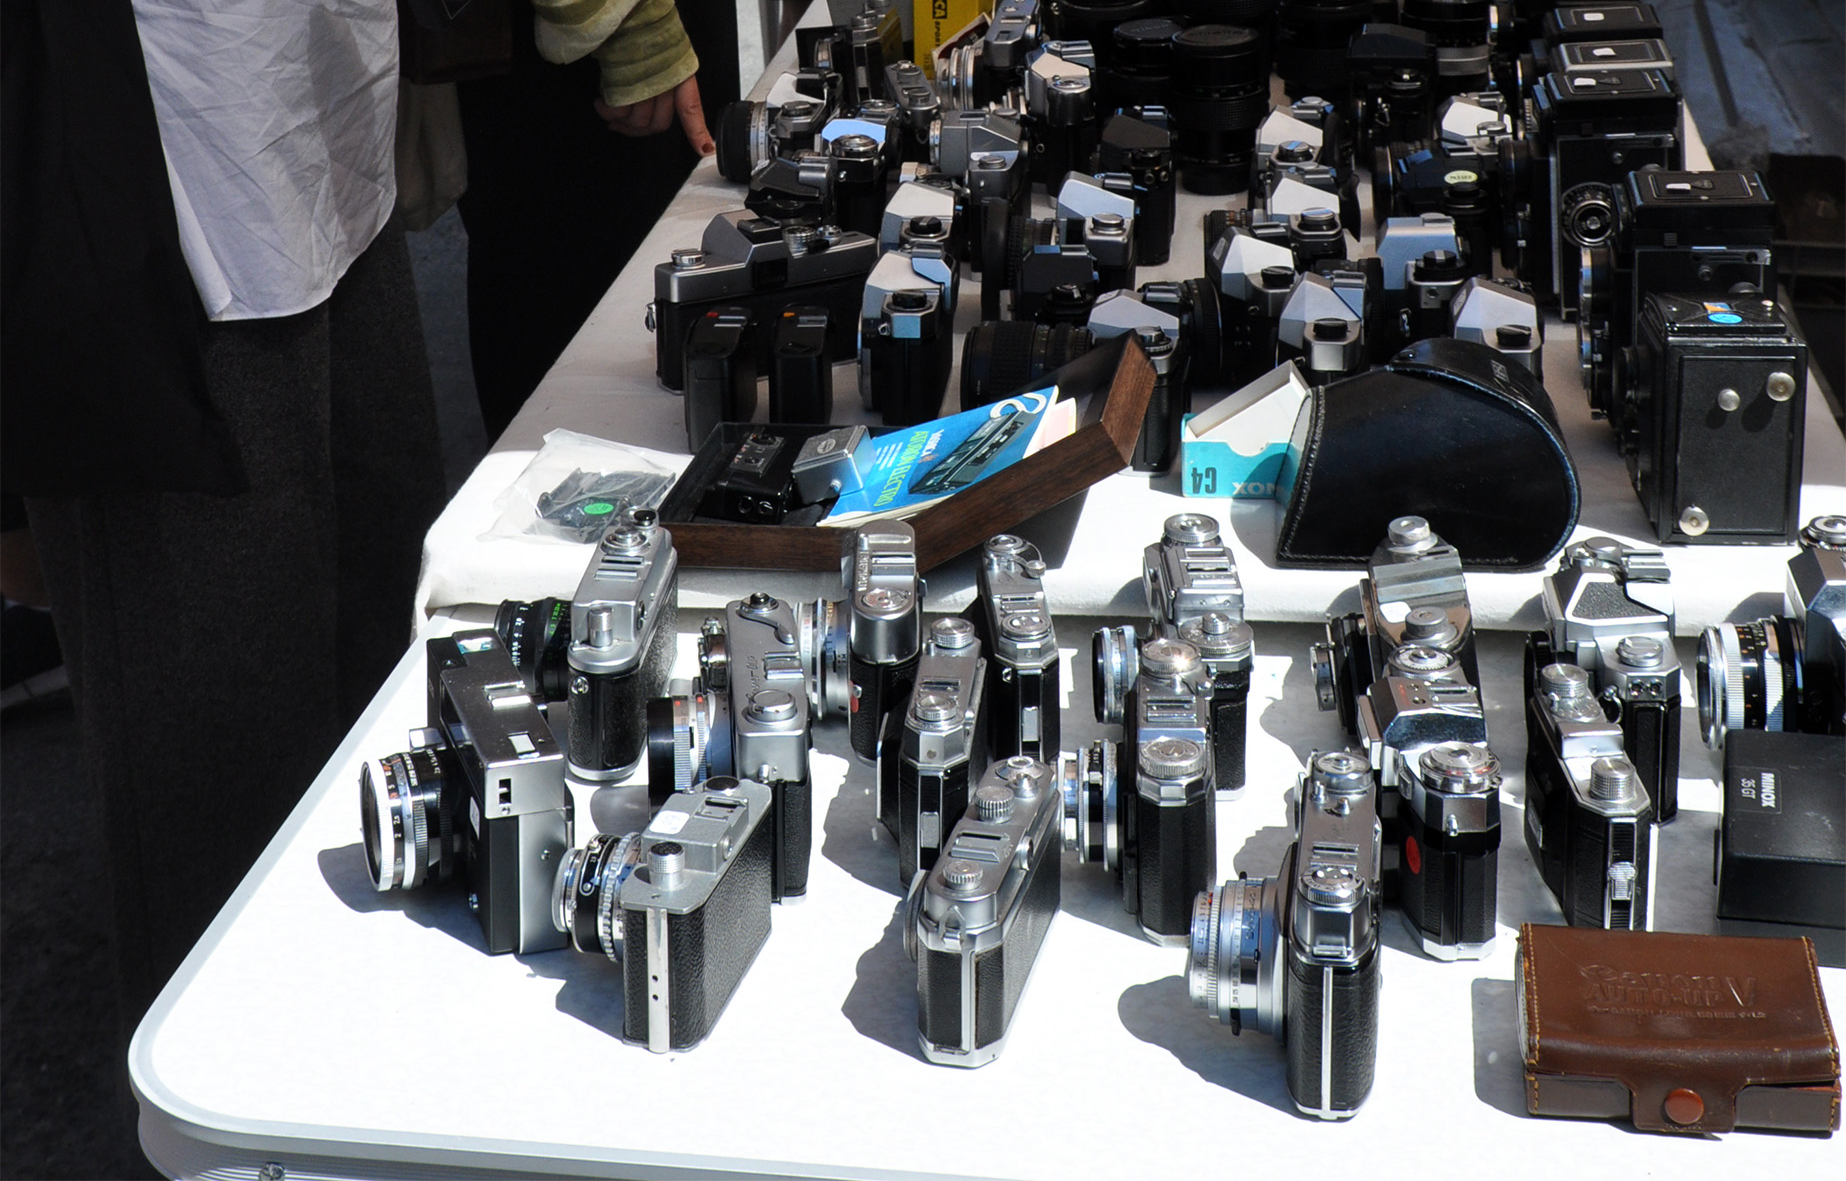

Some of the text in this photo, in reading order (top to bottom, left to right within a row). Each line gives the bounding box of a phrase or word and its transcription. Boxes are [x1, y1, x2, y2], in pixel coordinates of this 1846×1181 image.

[872, 465, 913, 507] ELECTRO
[1191, 467, 1217, 495] C4
[1740, 778, 1756, 799] 35 GT
[1760, 772, 1776, 808] MINOX
[1580, 963, 1757, 1007] Canon V
[1584, 983, 1725, 1007] AUTO-UP
